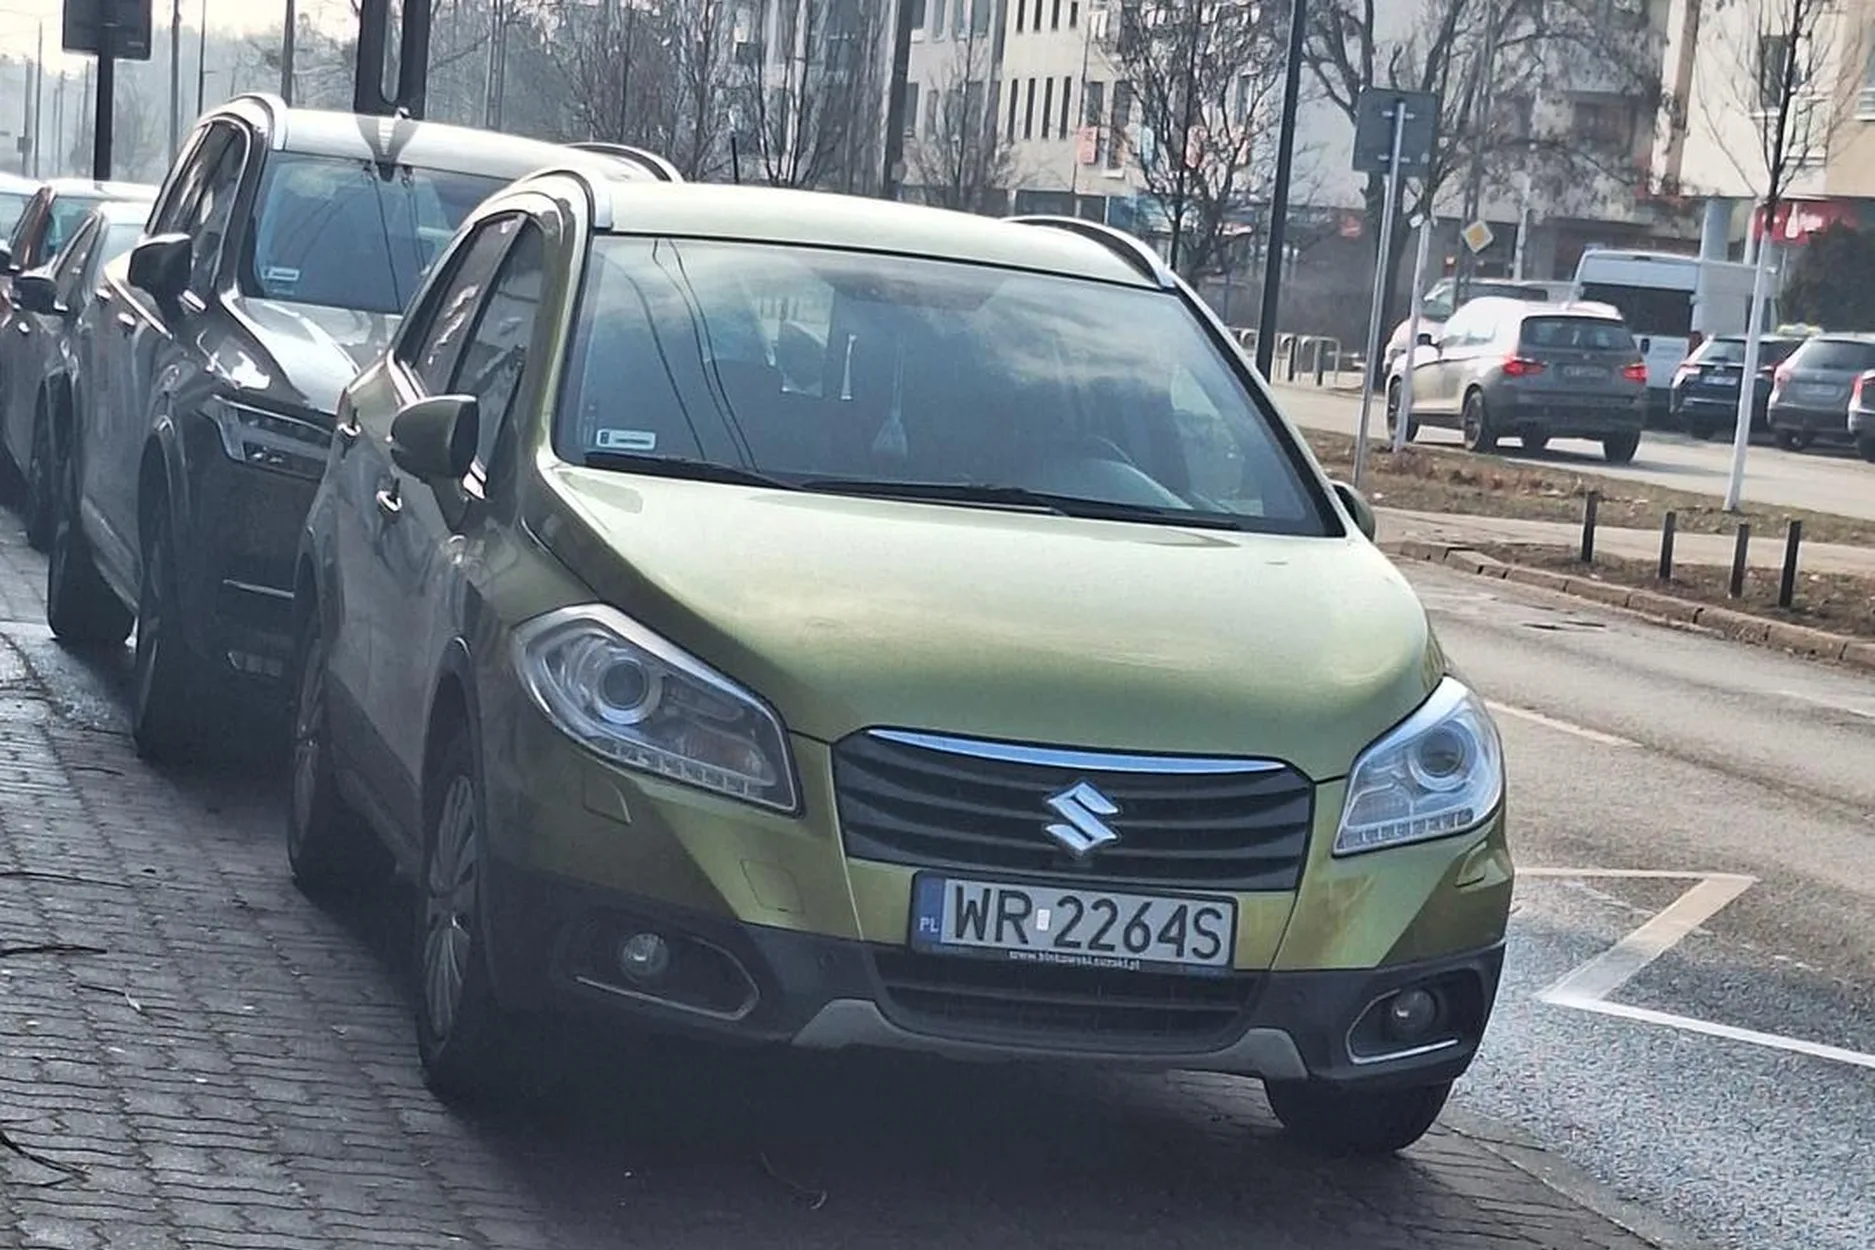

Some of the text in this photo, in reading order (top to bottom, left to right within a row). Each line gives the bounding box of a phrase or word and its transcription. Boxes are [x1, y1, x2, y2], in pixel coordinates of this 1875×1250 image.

[919, 915, 940, 933] PL
[955, 885, 1223, 960] WR 2264S
